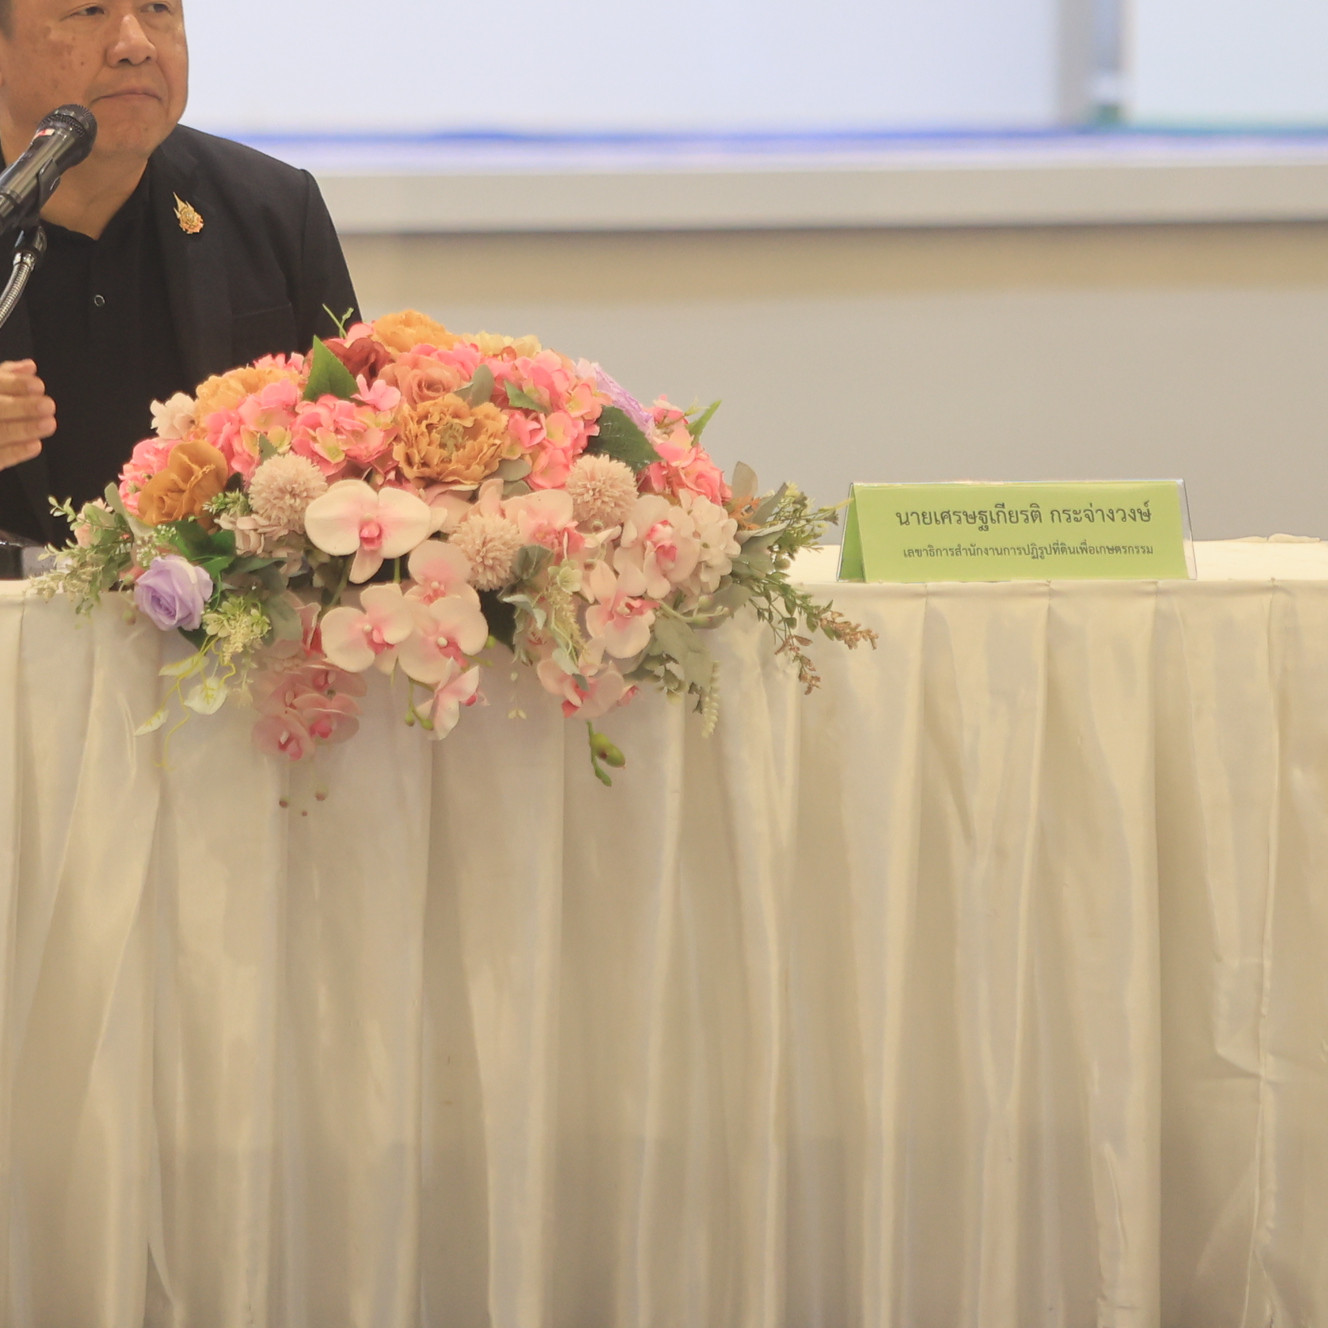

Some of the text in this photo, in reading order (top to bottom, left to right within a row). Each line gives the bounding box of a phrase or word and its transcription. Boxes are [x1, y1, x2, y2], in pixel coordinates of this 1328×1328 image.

[895, 500, 1152, 532] นายเศรษฐเกียรติ กระจ่างวงษ์
